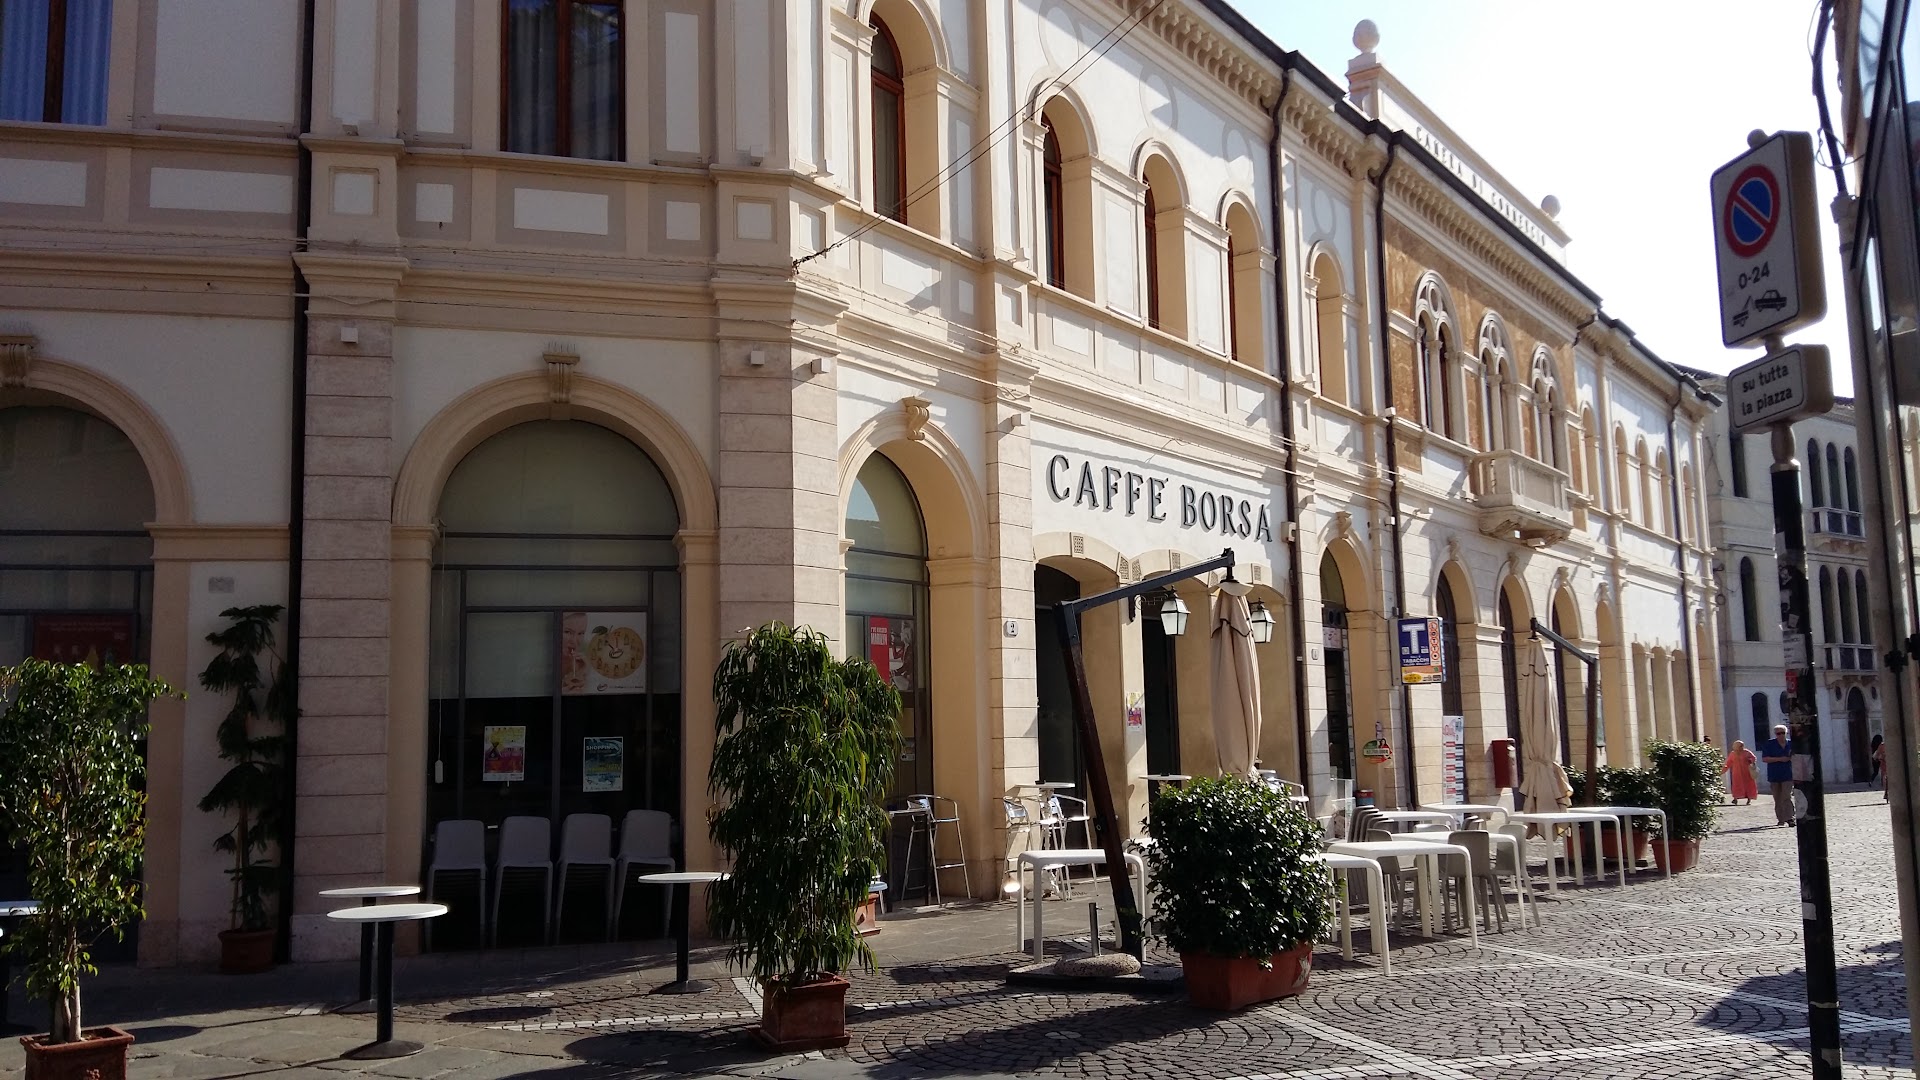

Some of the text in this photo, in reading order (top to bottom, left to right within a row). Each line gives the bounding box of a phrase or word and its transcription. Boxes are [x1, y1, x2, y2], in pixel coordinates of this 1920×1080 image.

[1416, 125, 1462, 177] CAMERA
[1472, 174, 1483, 194] DI
[1738, 261, 1770, 289] 0-24
[1742, 364, 1789, 393] su tutta
[1742, 387, 1793, 416] la piazza
[1180, 484, 1273, 543] BORSA
[1402, 623, 1426, 655] T
